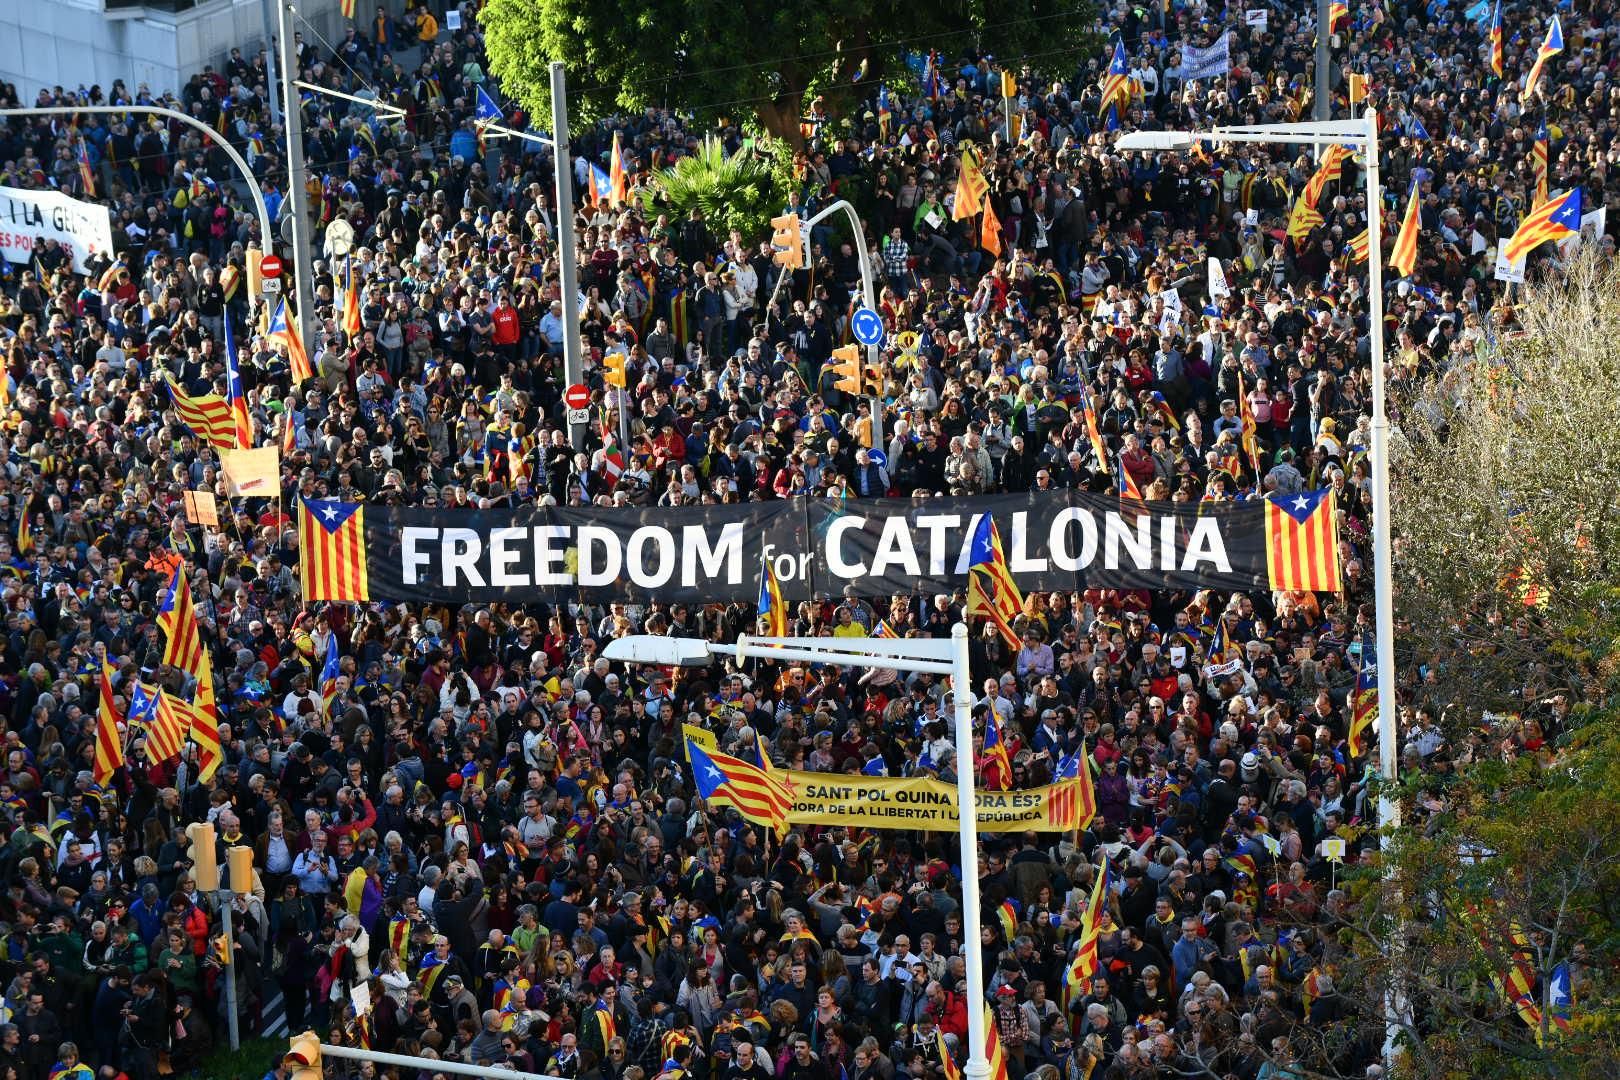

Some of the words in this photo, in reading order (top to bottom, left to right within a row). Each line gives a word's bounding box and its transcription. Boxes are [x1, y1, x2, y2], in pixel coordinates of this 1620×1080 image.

[10, 200, 16, 223] I
[22, 202, 44, 227] LA
[401, 523, 744, 588] FREEDOM
[759, 544, 815, 582] for
[806, 785, 852, 800] SANT
[857, 789, 890, 802] POL
[895, 790, 951, 806] QUINA
[957, 794, 1007, 808] ORA
[1012, 791, 1042, 808] ÉS?
[829, 804, 845, 814] DE
[849, 805, 866, 816] LA
[869, 806, 938, 819] LLIBERTAT
[941, 809, 945, 819] I
[949, 809, 960, 820] L
[975, 810, 1042, 823] EPÚBLICA
